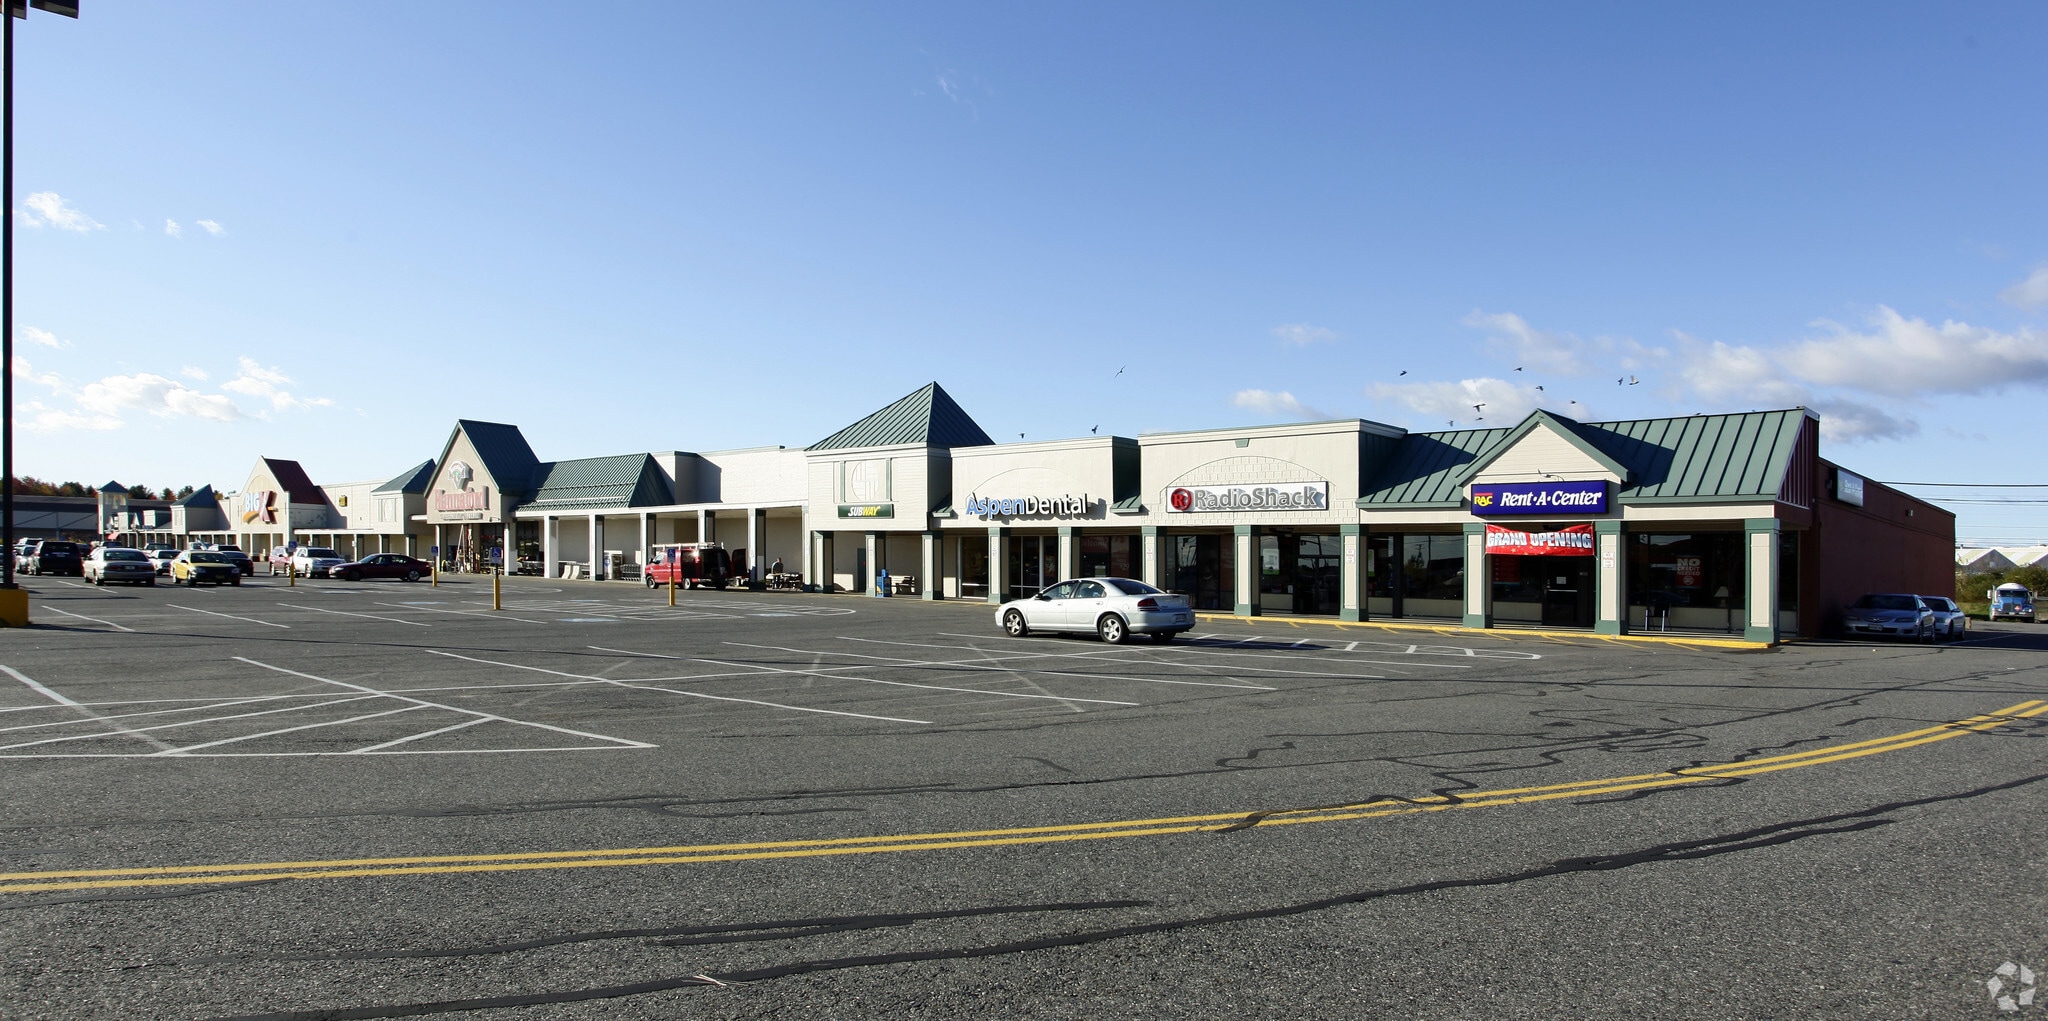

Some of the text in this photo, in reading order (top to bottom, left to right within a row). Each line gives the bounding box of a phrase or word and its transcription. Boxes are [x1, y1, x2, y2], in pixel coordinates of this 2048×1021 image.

[1194, 486, 1317, 508] RadioShack
[1474, 496, 1493, 506] RAC
[848, 506, 880, 517] SUBWAY
[966, 493, 1087, 519] AspenDental
[1487, 532, 1528, 548] GRAND
[1677, 558, 1700, 567] NO
